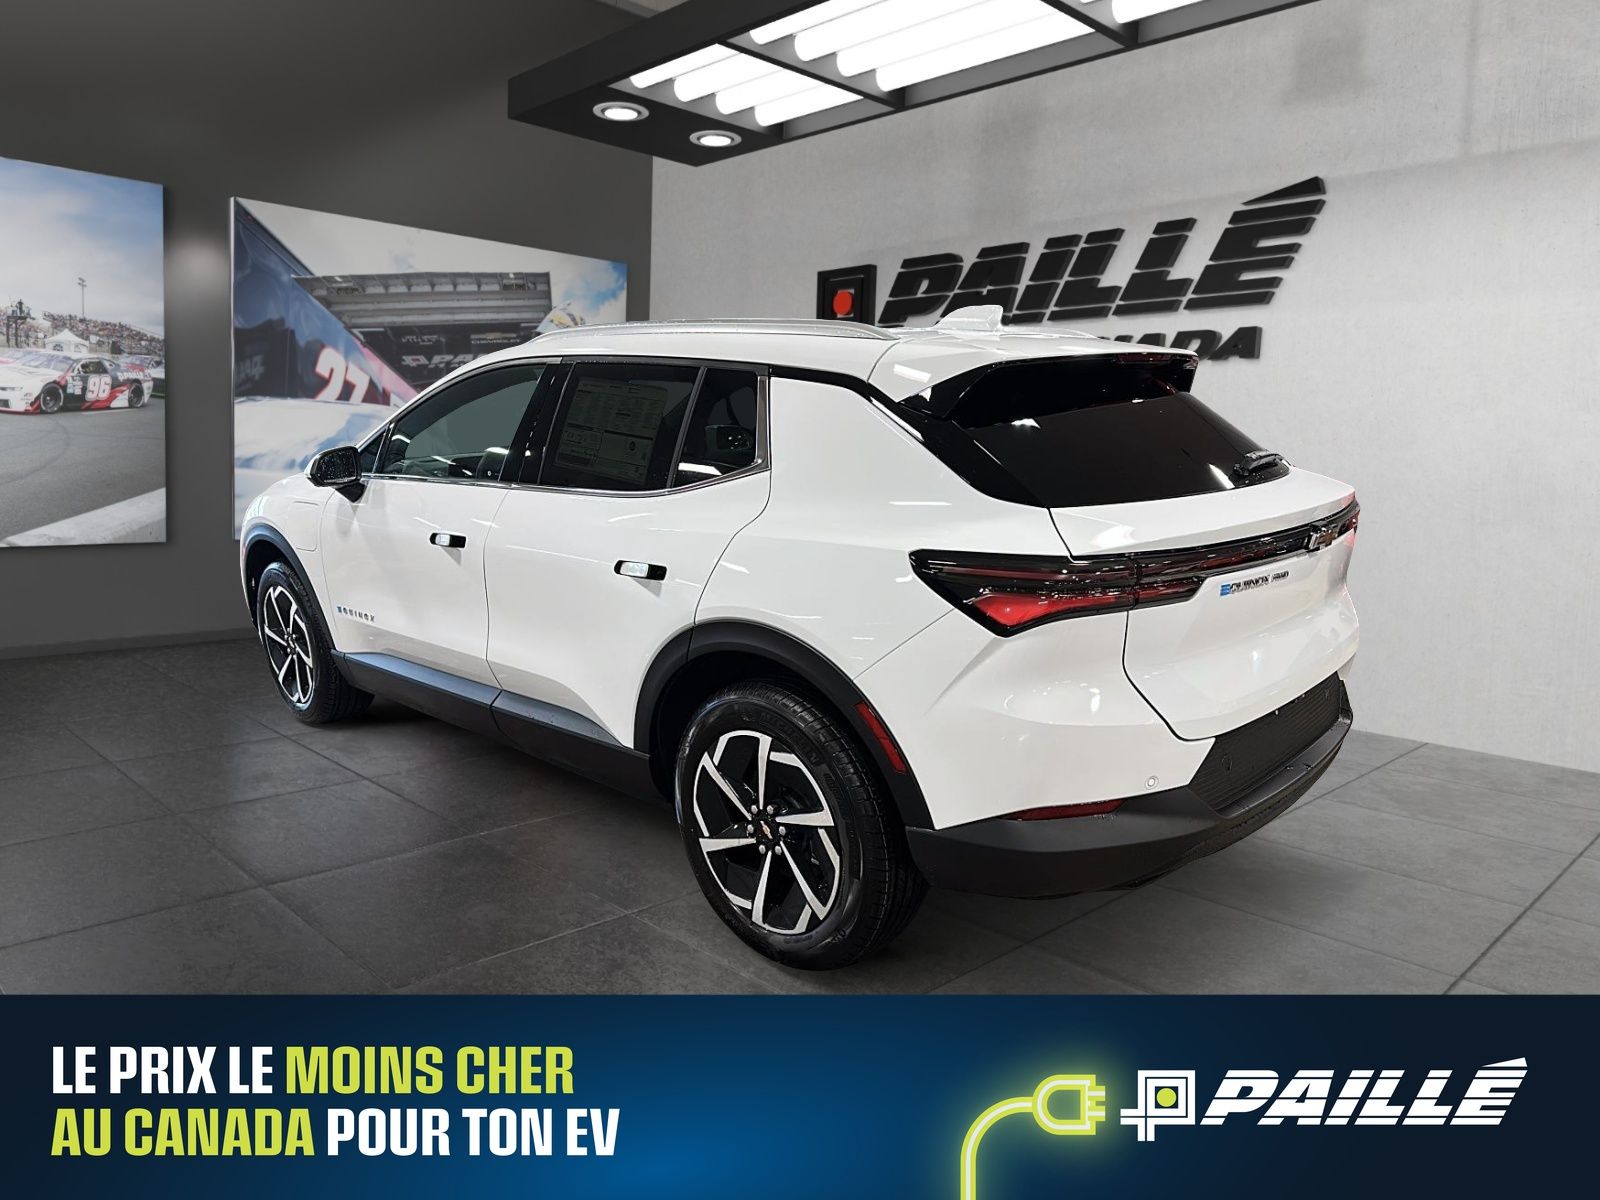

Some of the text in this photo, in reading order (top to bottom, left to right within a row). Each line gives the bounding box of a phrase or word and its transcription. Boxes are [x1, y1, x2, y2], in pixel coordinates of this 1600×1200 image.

[878, 176, 1326, 325] PAILLÉ
[85, 374, 112, 402] 96
[314, 346, 371, 403] 27
[336, 606, 375, 622] EQUINOX
